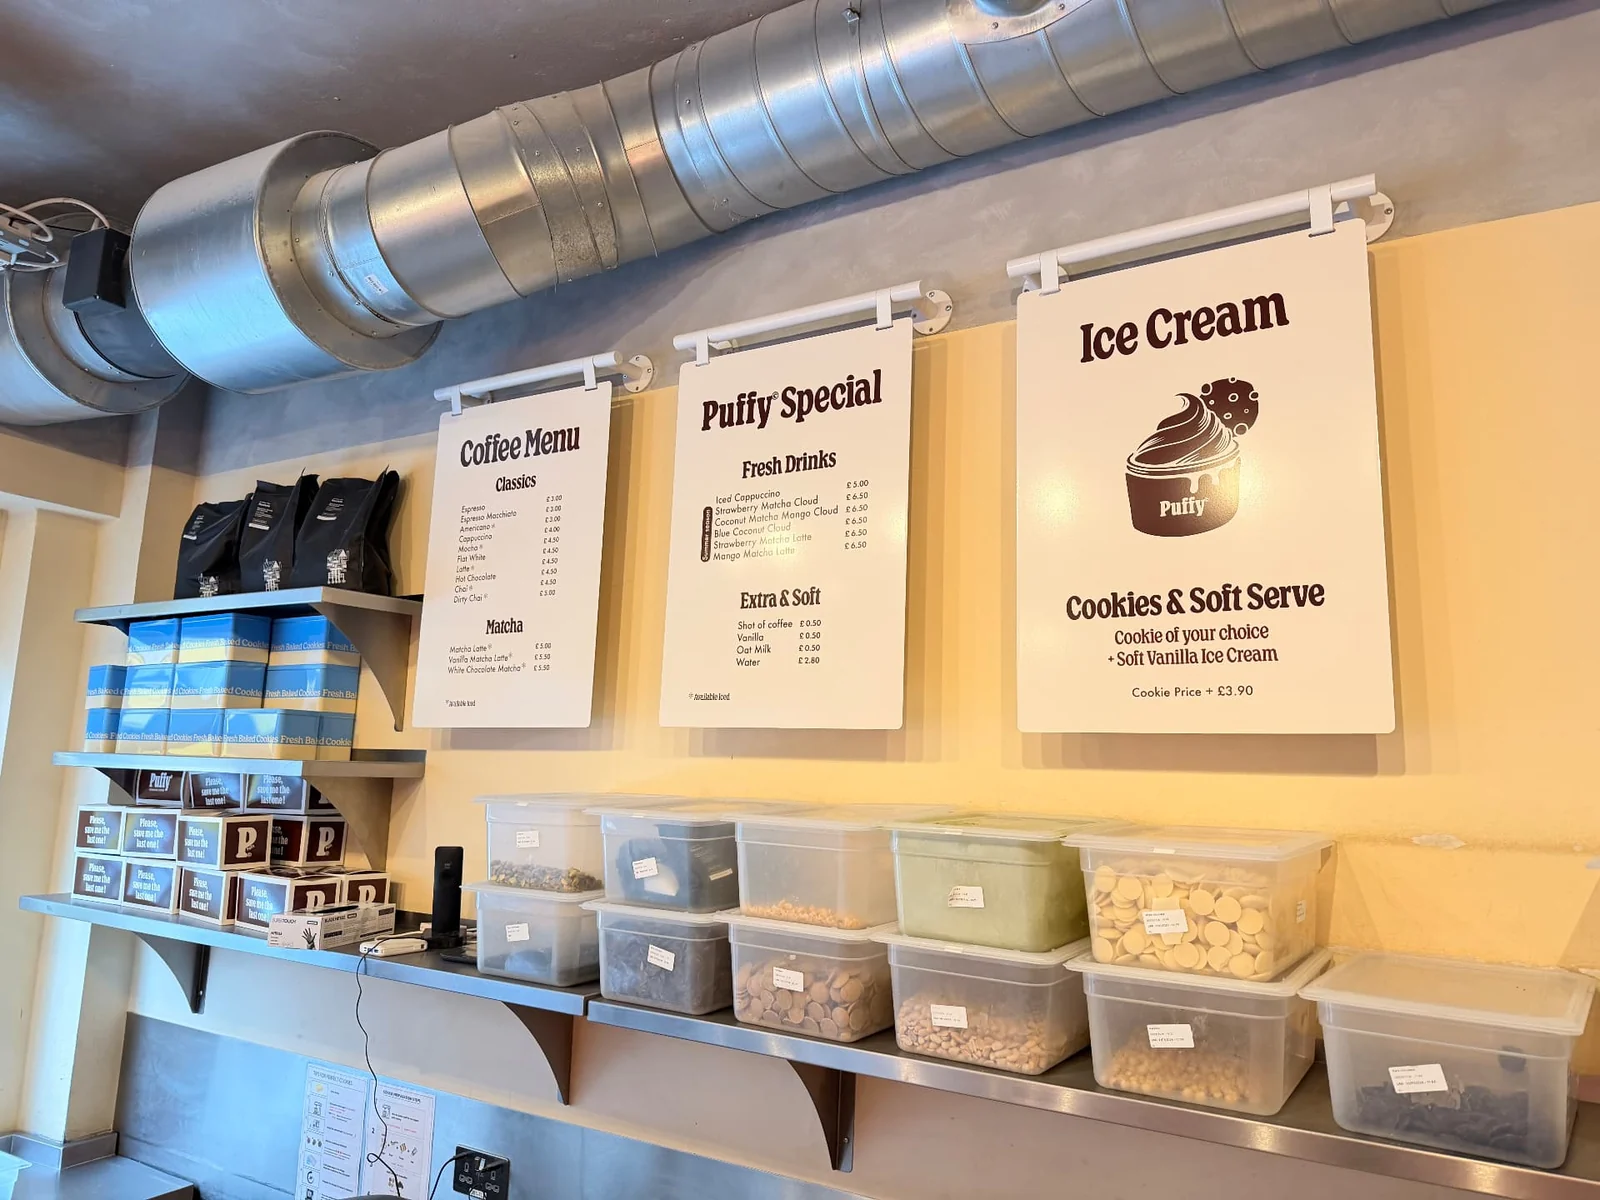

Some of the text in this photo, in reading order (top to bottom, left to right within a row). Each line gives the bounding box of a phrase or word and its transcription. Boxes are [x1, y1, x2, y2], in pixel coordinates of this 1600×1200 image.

[1080, 292, 1290, 363] Ice Cream
[780, 368, 882, 423] Special
[460, 426, 580, 467] Coffee Menu
[741, 449, 836, 479] Fresh Drinks
[495, 473, 536, 492] Classics
[715, 489, 781, 504] Iced Cappuccino
[461, 505, 486, 515] Espresso
[715, 494, 819, 516] Strawberry Matcha Cloud
[1159, 496, 1206, 518] Puffy
[460, 510, 517, 525] Espresso Macchiato
[714, 504, 839, 527] Coconut Matcha Mango Cloud
[459, 524, 491, 533] Americano
[714, 521, 791, 538] Blue Coconut Cloud
[458, 532, 492, 544] Cappuccino
[713, 538, 755, 550] Strawberry
[792, 533, 812, 542] Latte
[457, 545, 478, 553] Mocha
[712, 552, 741, 562] Mango
[742, 547, 773, 558] Matcha
[456, 553, 486, 563] Flat White
[456, 565, 470, 573] Latte
[455, 572, 496, 583] Hot Chocolate
[454, 584, 468, 593] Chai
[453, 593, 483, 605] Dirty Chai
[740, 586, 821, 609] Extra & Soft
[1066, 582, 1325, 621] Cookies & Soft Serve
[485, 617, 523, 635] Matcha
[737, 618, 793, 630] Shot of coffee
[736, 632, 764, 642] Vanilla
[1114, 623, 1269, 646] Cookie of your choice
[472, 645, 487, 653] Latte
[736, 644, 771, 654] Oat Milk
[448, 654, 508, 664] Vanilla Matcha Latte
[735, 657, 760, 667] Water
[1117, 649, 1145, 666] Soft
[1146, 648, 1199, 665] Vanilla
[1201, 648, 1224, 664] Ice
[1226, 647, 1279, 663] Cream
[447, 664, 521, 674] White Chocolate Matcha
[235, 687, 263, 697] Cookie
[265, 688, 345, 698] Fresh Baked Cookies Fresh
[1132, 686, 1170, 698] Cookie
[1174, 686, 1202, 697] Price
[1217, 685, 1253, 696] £3.90
[256, 735, 279, 744] Cookies
[280, 735, 305, 744] Fresh
[325, 738, 352, 746] Cookie
[149, 772, 174, 792] Puffy
